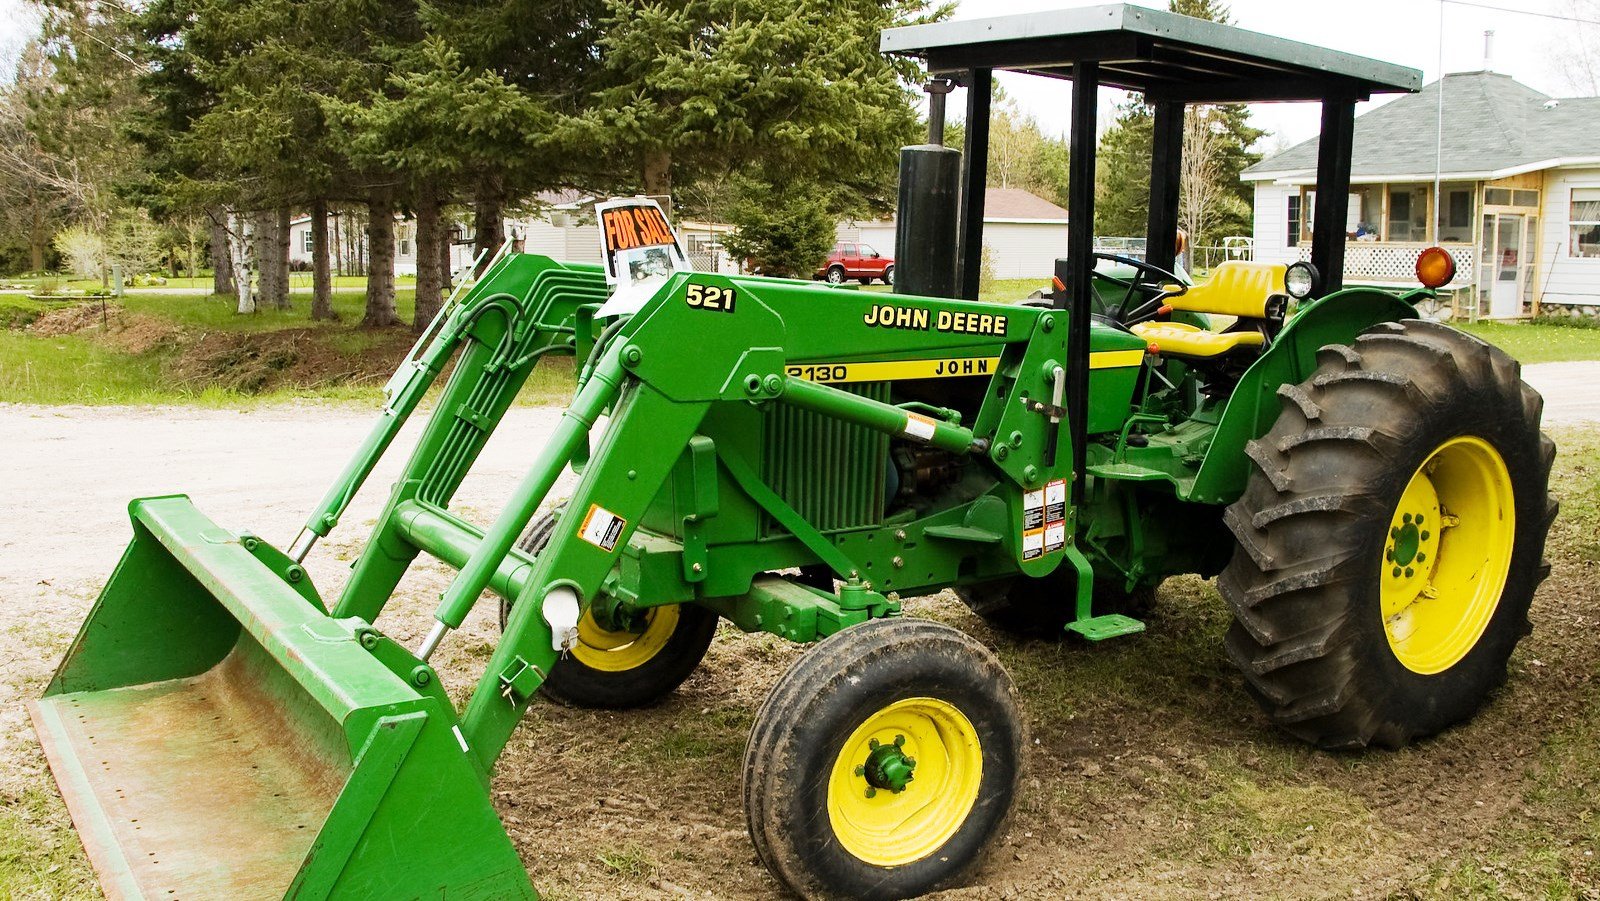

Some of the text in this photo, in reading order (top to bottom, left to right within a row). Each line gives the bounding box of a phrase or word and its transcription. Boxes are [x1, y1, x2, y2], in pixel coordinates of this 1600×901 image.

[603, 207, 675, 251] FOR SALE
[685, 283, 735, 312] 521
[864, 304, 1008, 336] JOHN DEERE
[935, 359, 988, 375] JOHN
